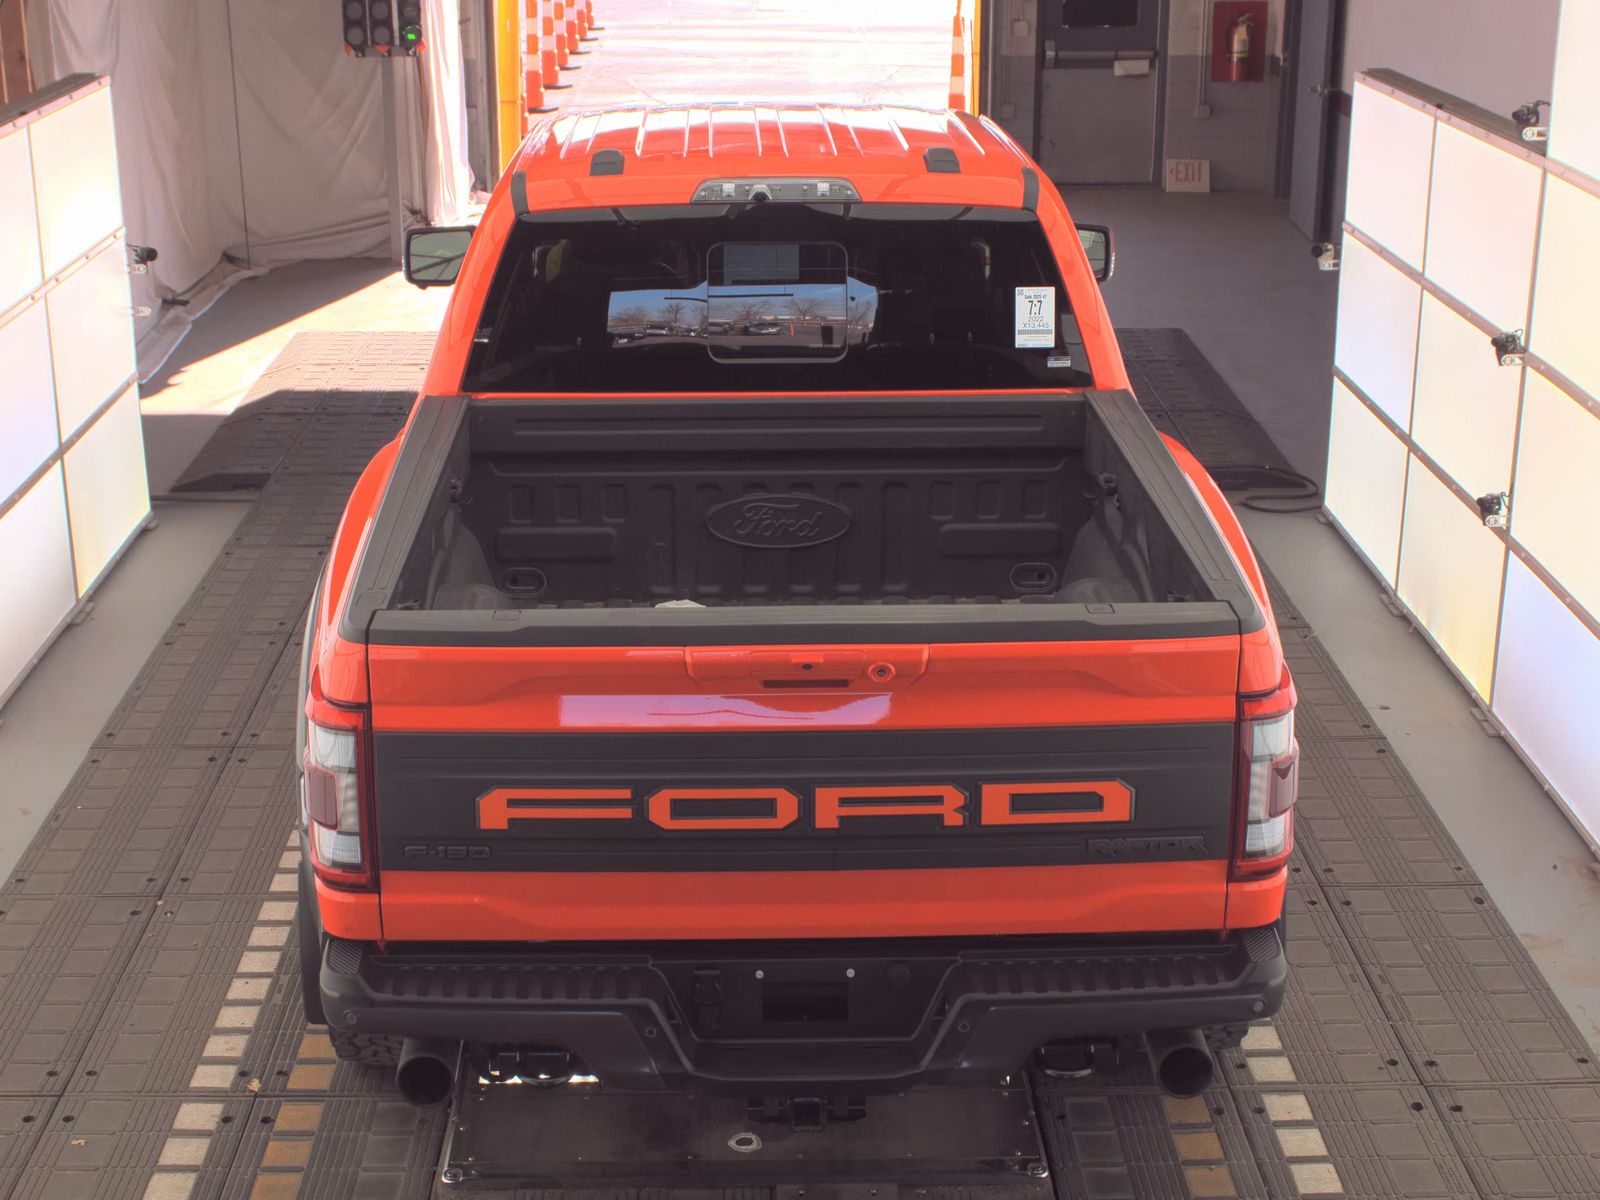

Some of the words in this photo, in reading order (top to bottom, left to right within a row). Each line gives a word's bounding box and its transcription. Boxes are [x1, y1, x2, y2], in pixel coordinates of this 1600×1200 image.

[1028, 300, 1042, 315] 7:7
[732, 501, 823, 537] Ford
[479, 780, 1133, 831] FORD
[403, 844, 493, 860] F-150
